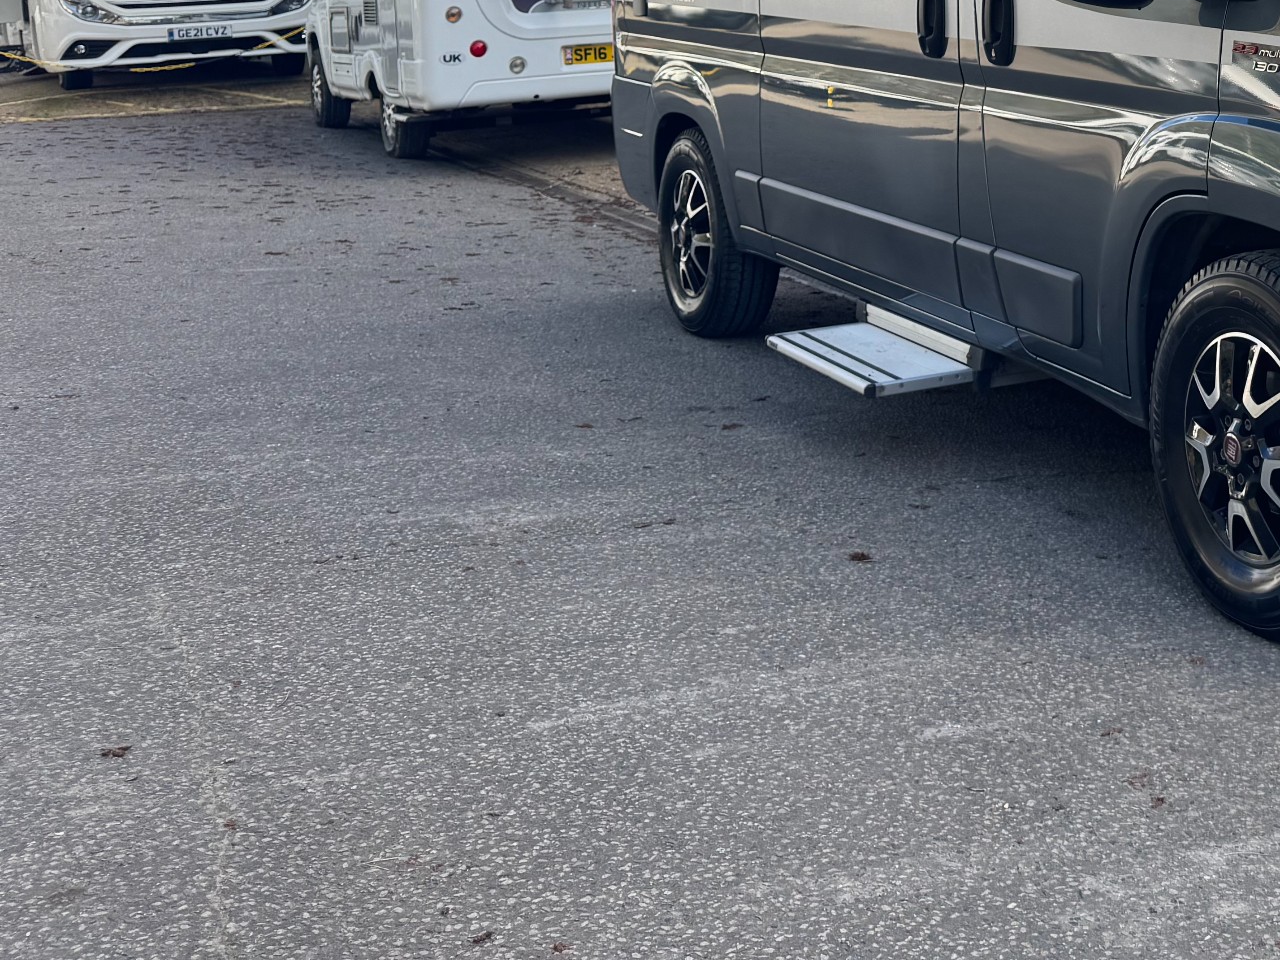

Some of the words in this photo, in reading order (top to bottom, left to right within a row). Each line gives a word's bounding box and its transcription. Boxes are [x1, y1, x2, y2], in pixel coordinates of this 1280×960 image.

[177, 27, 203, 39] GE21
[205, 26, 228, 37] CVZ
[442, 53, 463, 63] UK
[573, 46, 608, 62] SF16
[1252, 60, 1280, 74] 130
[1227, 439, 1237, 460] FIAT
